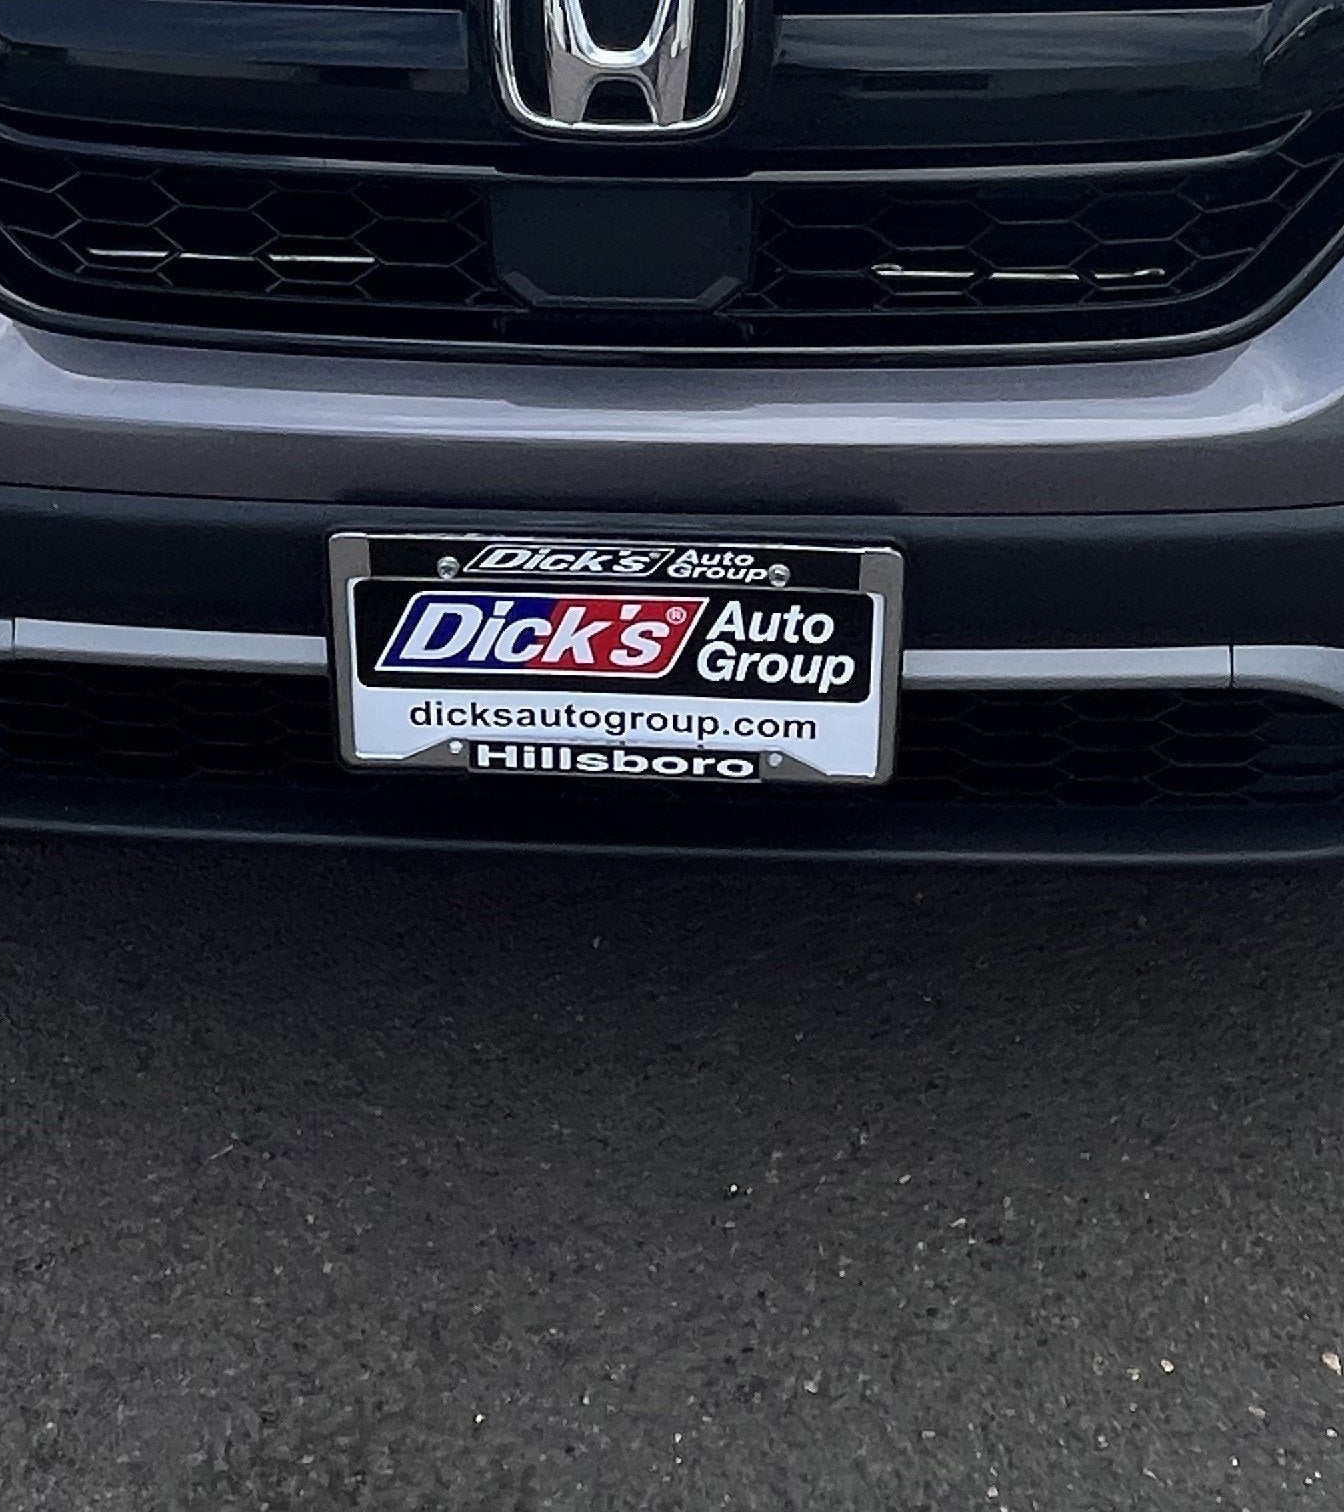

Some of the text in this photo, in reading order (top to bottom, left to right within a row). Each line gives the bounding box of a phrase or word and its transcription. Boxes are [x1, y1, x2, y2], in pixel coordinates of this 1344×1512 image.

[478, 548, 652, 572] Dick's
[666, 563, 768, 584] Group
[674, 549, 755, 567] Auto
[399, 600, 671, 668] Dick's
[705, 600, 835, 646] Auto
[697, 641, 856, 694] Group
[409, 700, 817, 739] dicksautogroup.com
[476, 743, 755, 778] Hillsboro
